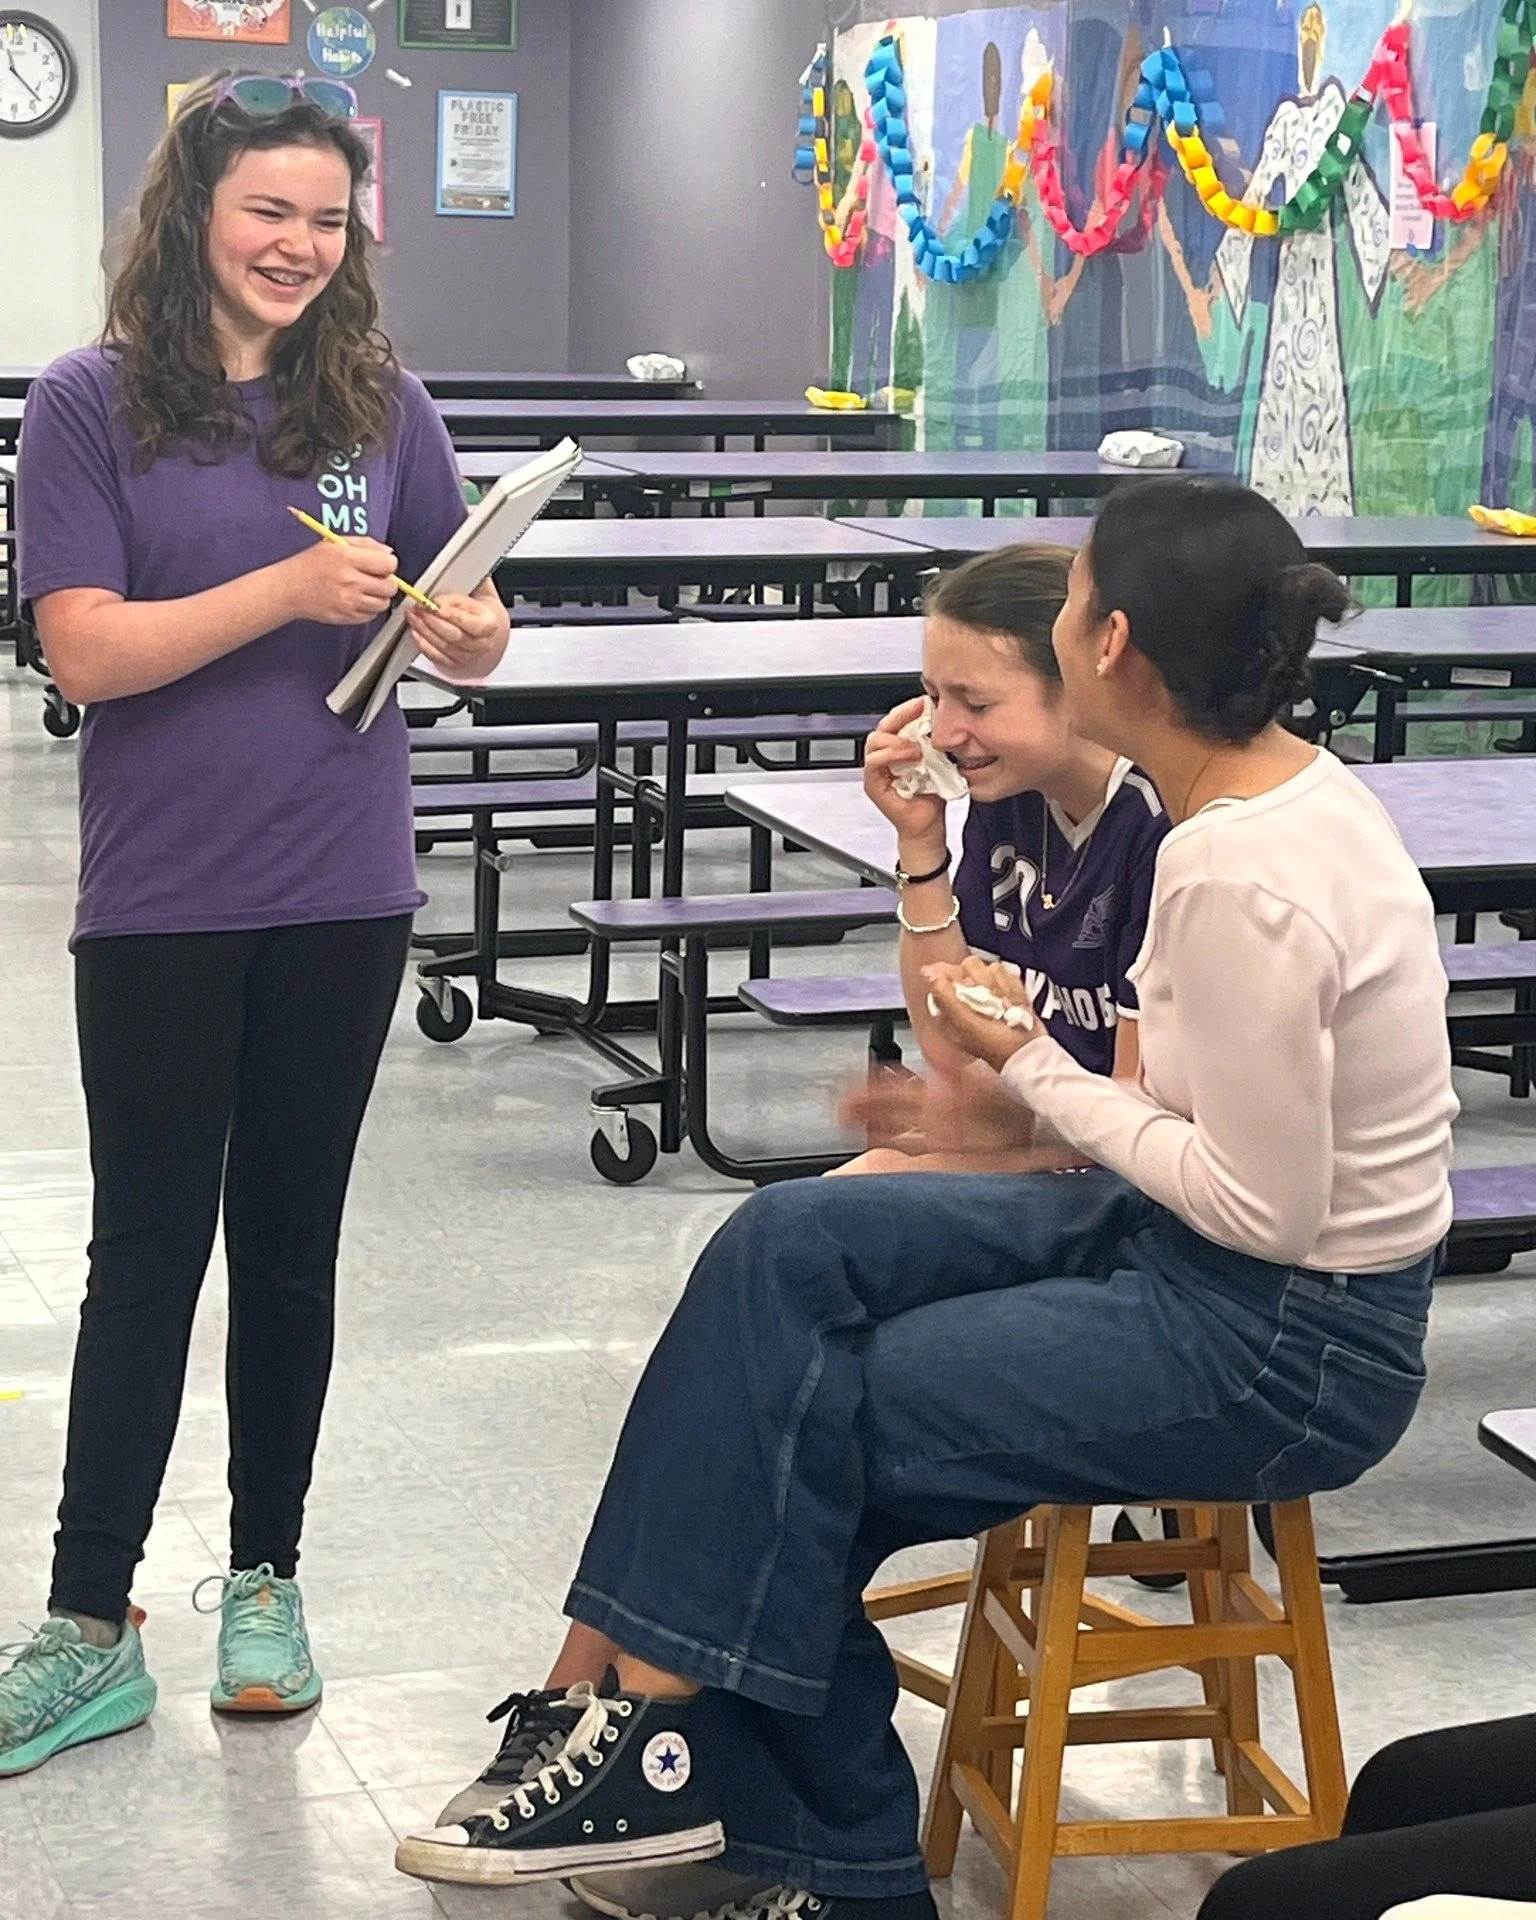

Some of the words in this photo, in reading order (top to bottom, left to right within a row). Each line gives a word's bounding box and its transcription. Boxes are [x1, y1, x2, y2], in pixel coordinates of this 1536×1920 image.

[451, 99, 505, 113] PLASTIC
[461, 112, 494, 125] FREE
[453, 123, 501, 136] FRIDAY
[317, 474, 367, 503] OH
[321, 503, 368, 535] MS
